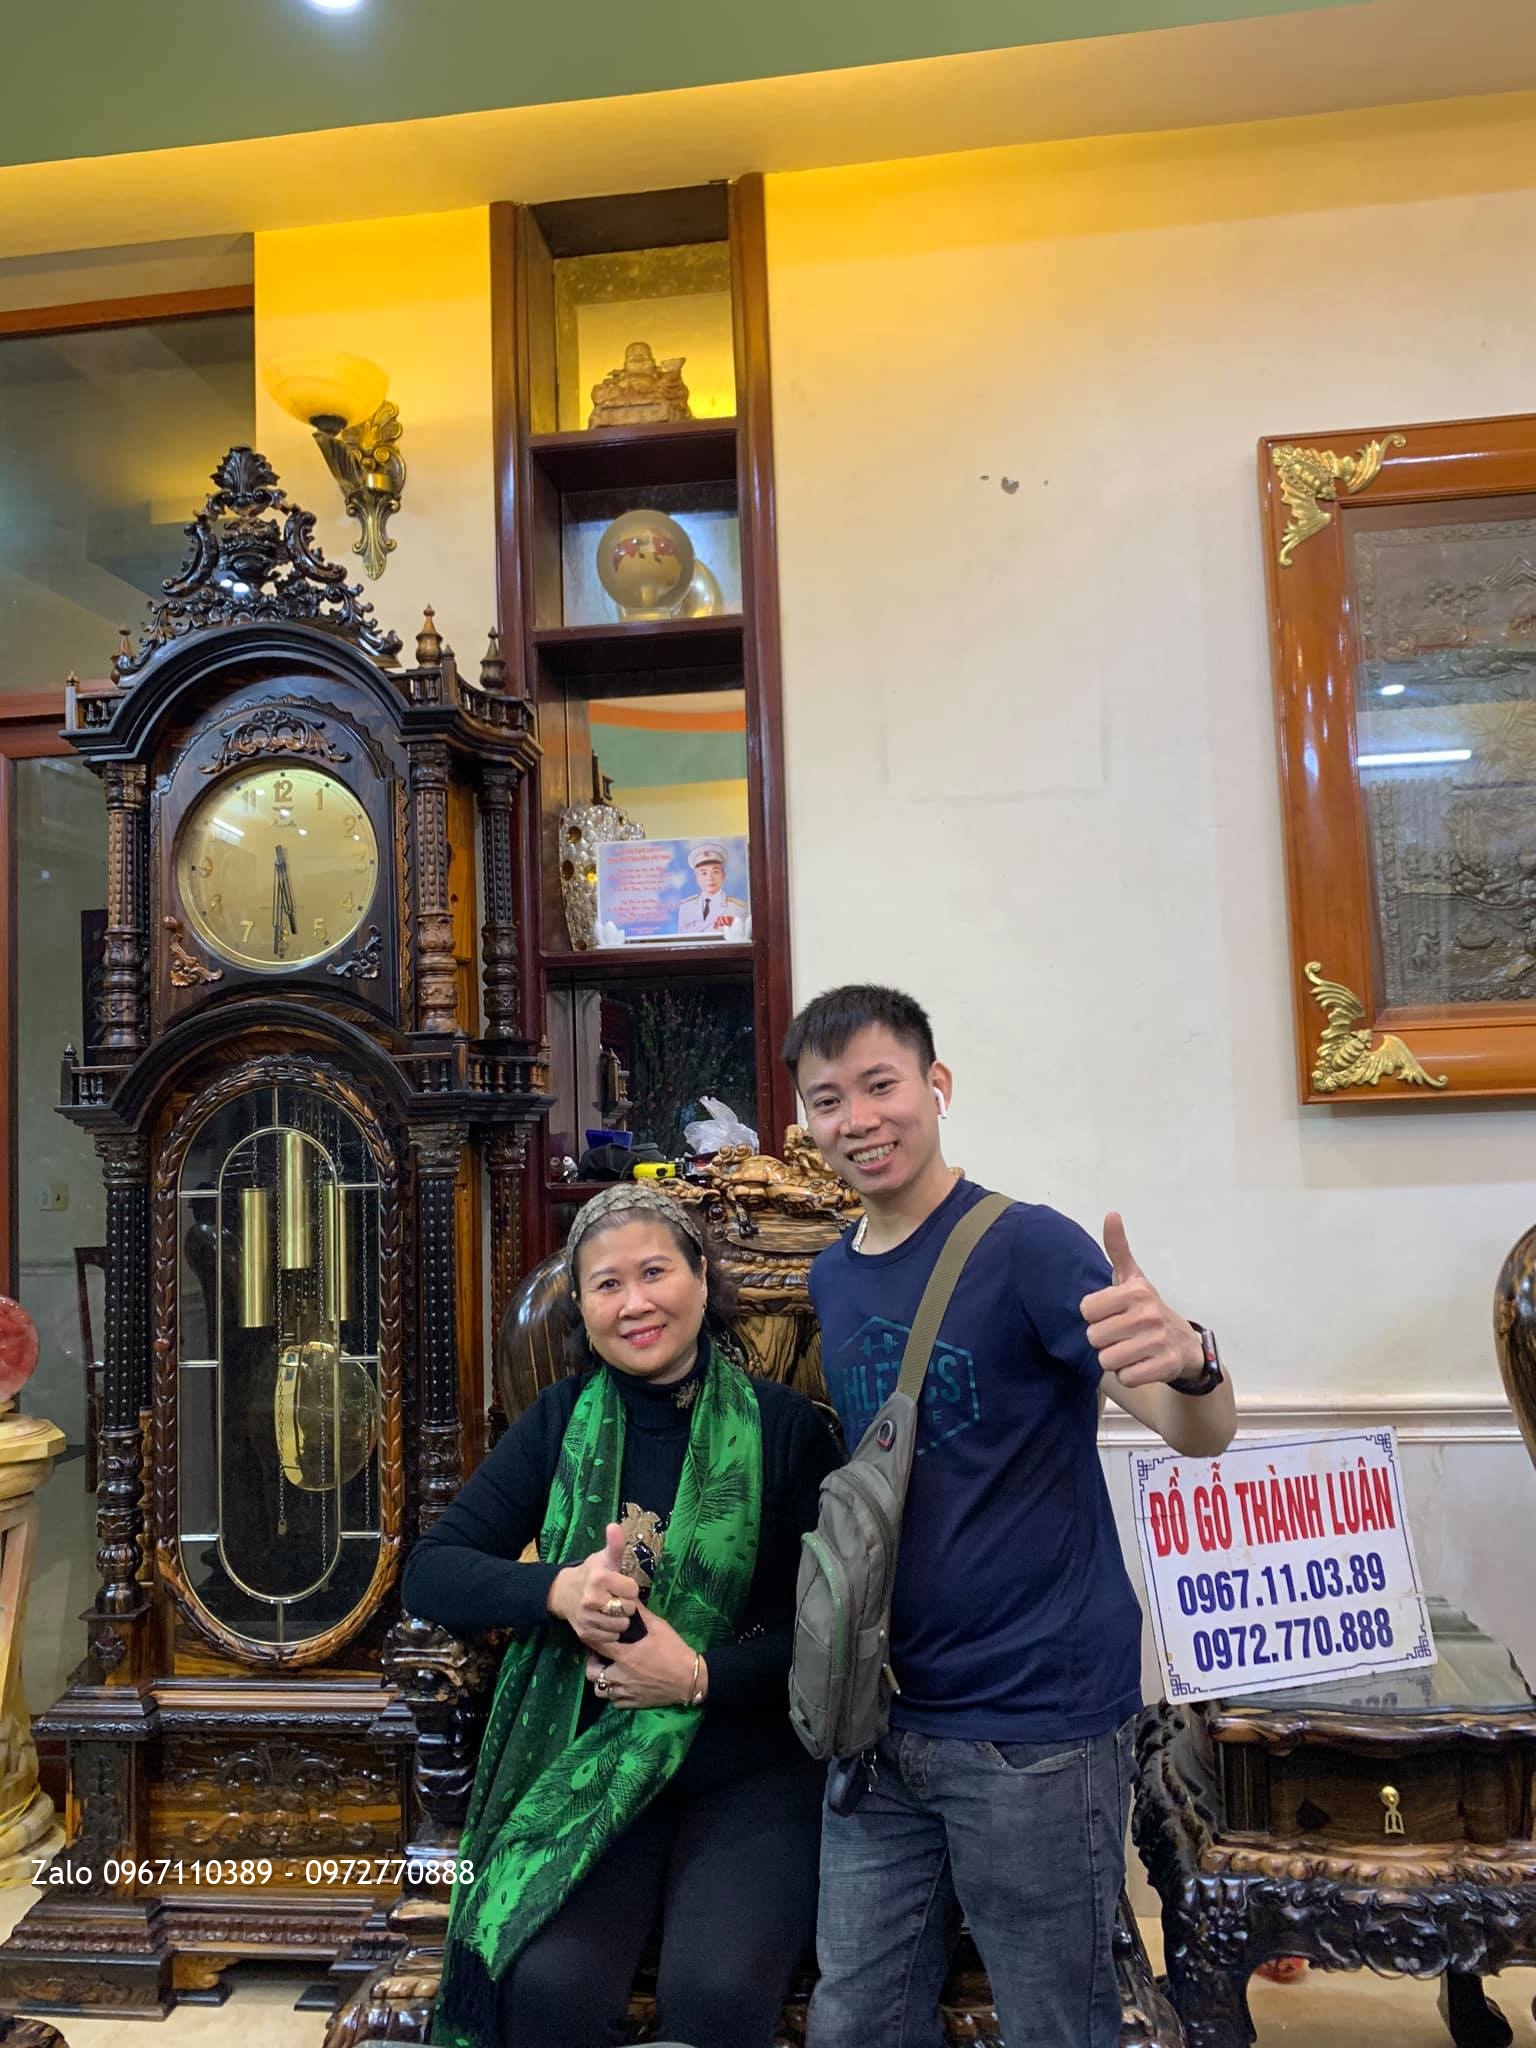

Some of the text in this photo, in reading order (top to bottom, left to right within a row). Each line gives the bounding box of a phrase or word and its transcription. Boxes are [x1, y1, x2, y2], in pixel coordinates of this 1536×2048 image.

[274, 780, 293, 802] 12
[315, 788, 323, 810] 1
[239, 920, 255, 943] 7
[313, 917, 328, 940] 5
[1149, 1456, 1396, 1557] ĐỒ GỖ THÀNH LUÂN
[1177, 1552, 1386, 1616] 0967.11.03.89
[1193, 1608, 1394, 1672] 0972.770.888
